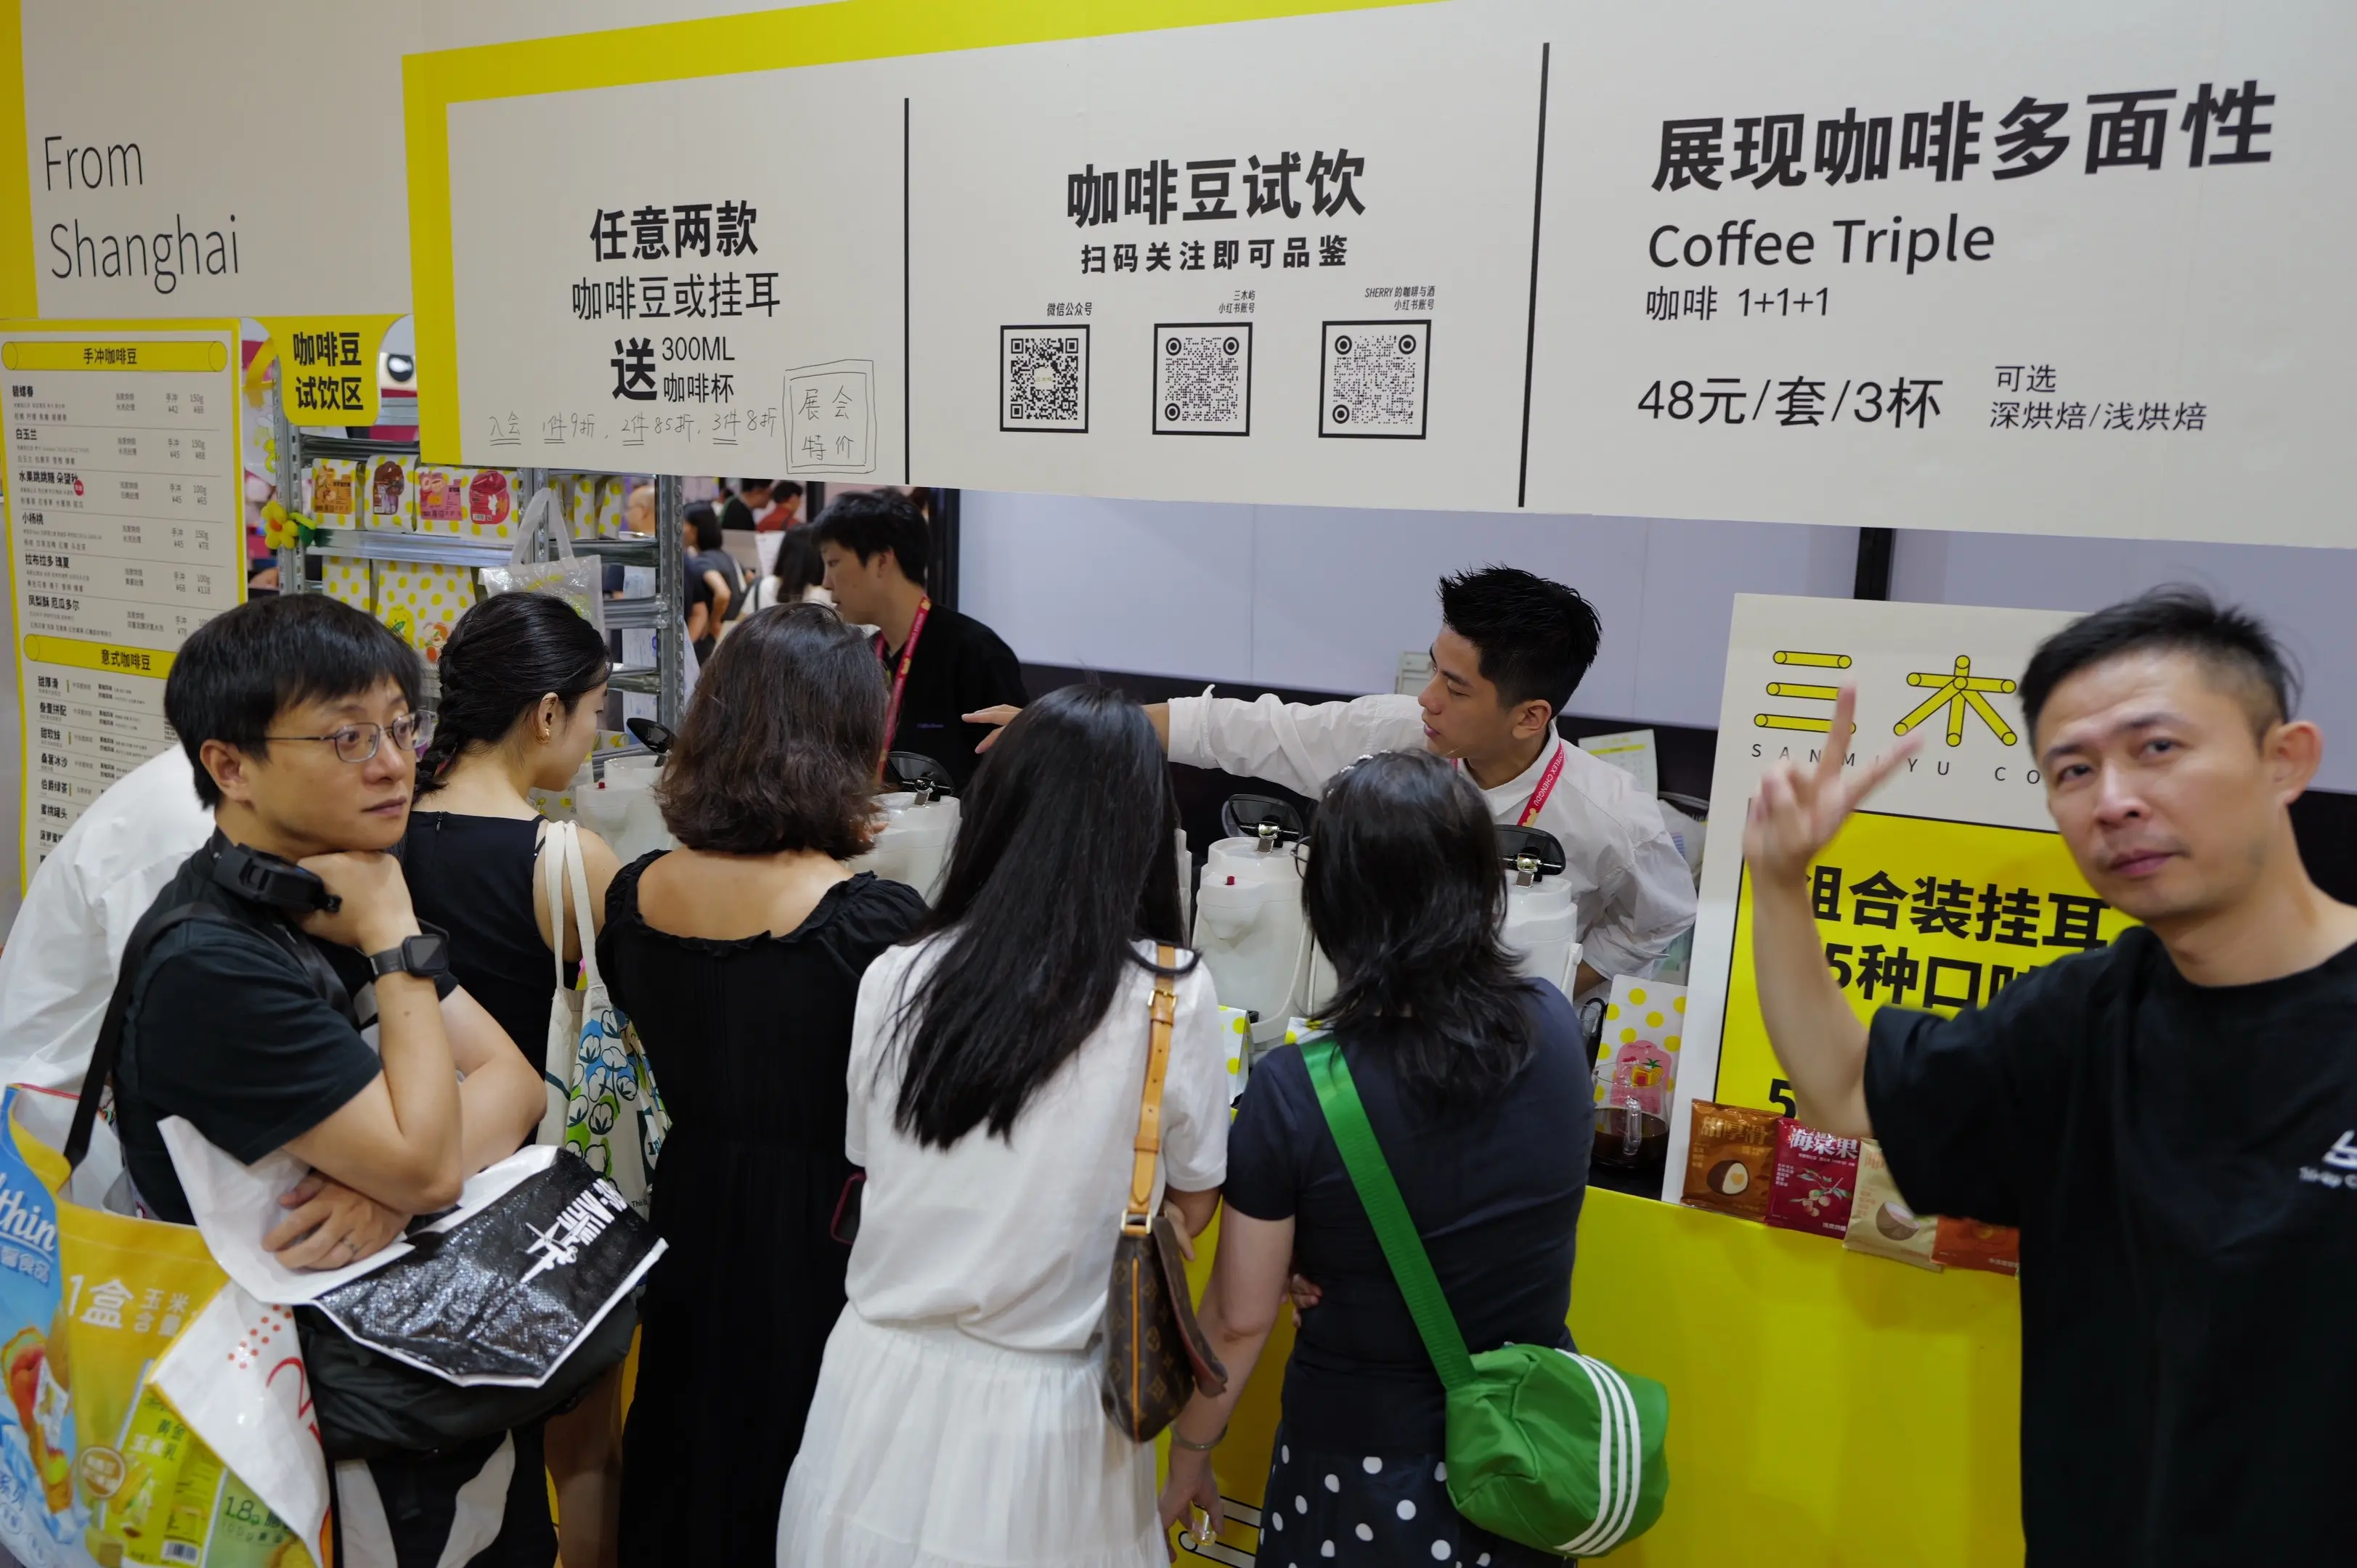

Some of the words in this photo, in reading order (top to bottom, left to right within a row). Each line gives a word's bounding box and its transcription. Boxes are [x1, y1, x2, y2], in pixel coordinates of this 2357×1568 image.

[1651, 80, 2276, 193] 展现咖啡多面性
[44, 136, 143, 190] From
[1067, 148, 1366, 229] 咖啡豆试饮
[590, 200, 757, 262] 任意两款
[1648, 218, 1815, 268] Coffee
[1832, 213, 1995, 275] Triple
[50, 213, 239, 294] Shanghai
[1081, 234, 1348, 274] 扫码关注即可品鉴
[572, 272, 780, 320] 咖啡豆或挂耳
[1233, 290, 1255, 301] 三木屿
[1364, 287, 1393, 298] SHERRY
[1394, 286, 1436, 298] 的咖啡与酒
[1393, 299, 1435, 311] 小红书账号
[1645, 285, 1718, 322] 咖啡
[1738, 287, 1830, 317] 1+1+1
[1047, 302, 1092, 317] 微信公众号
[1218, 302, 1255, 314] 小红书账号
[84, 348, 137, 364] 手冲咖啡豆
[293, 331, 362, 367] 咖啡豆
[661, 336, 735, 362] 300ML
[611, 338, 657, 400] 送
[1994, 364, 2056, 393] 可选
[12, 385, 33, 398] 碧螺春
[296, 376, 363, 411] 试饮区
[664, 373, 734, 404] 咖啡杯
[798, 385, 852, 421] 展会
[1637, 375, 1944, 430] 48元/套/3杯
[489, 411, 521, 436] 入会
[1989, 400, 2208, 432] 深烘焙/浅烘焙
[16, 428, 37, 441] 白玉兰
[802, 435, 854, 460] 特价
[22, 512, 44, 526] 小杨桃
[25, 553, 54, 567] 拉布拉多
[51, 597, 80, 611] 厄瓜多尔
[101, 649, 151, 671] 意式咖啡豆
[41, 778, 68, 795] 伯爵绿茶
[1534, 771, 1554, 807] CHENGDU
[41, 804, 68, 820] 蜜桃罐头
[1789, 1127, 1859, 1159] 海棠果
